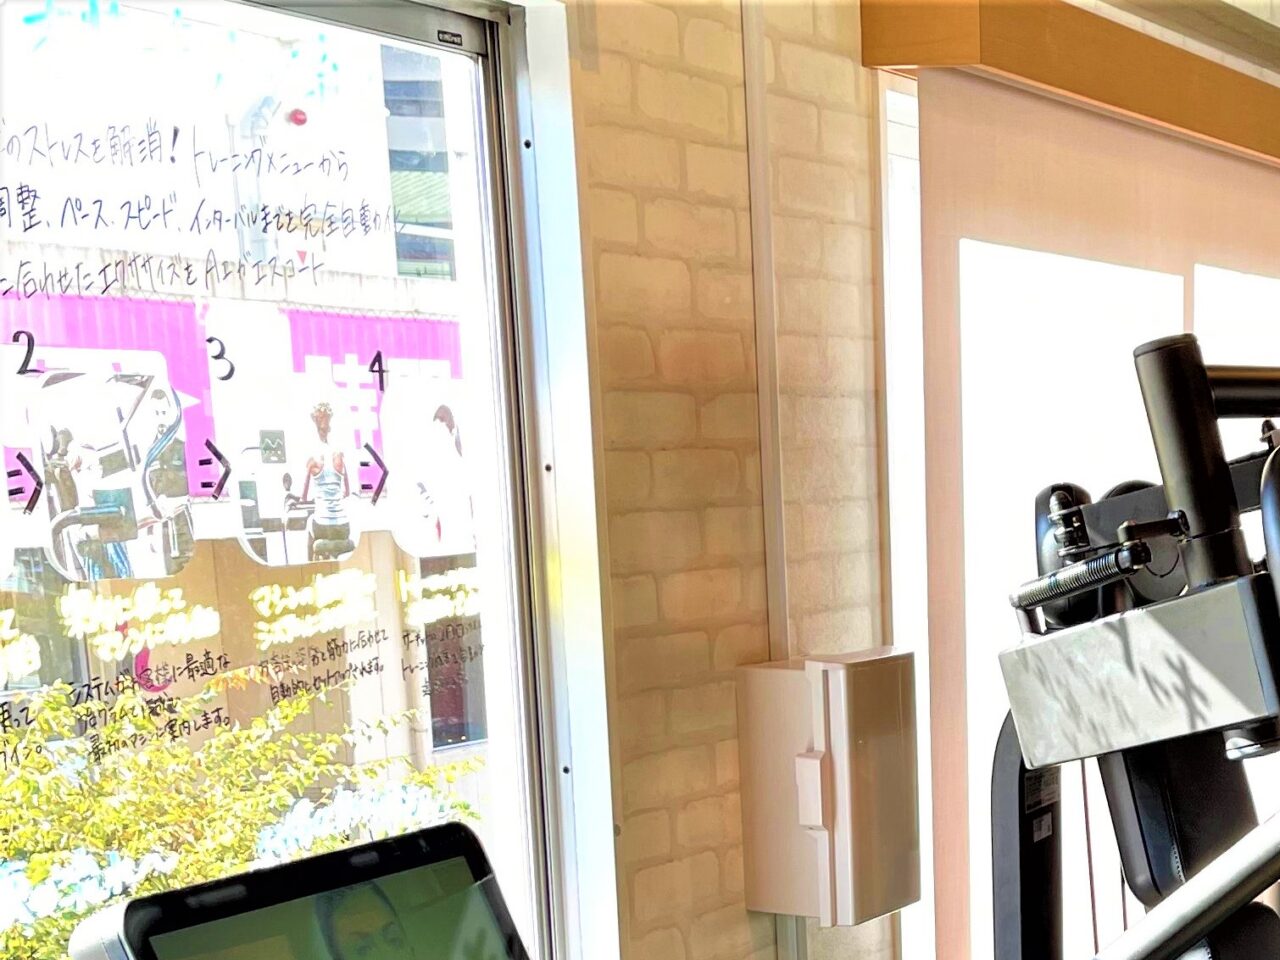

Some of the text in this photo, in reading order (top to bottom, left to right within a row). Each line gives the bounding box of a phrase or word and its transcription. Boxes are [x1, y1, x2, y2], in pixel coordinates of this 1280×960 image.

[13, 331, 44, 375] 2
[205, 336, 234, 381] 3
[369, 350, 389, 392] 4
